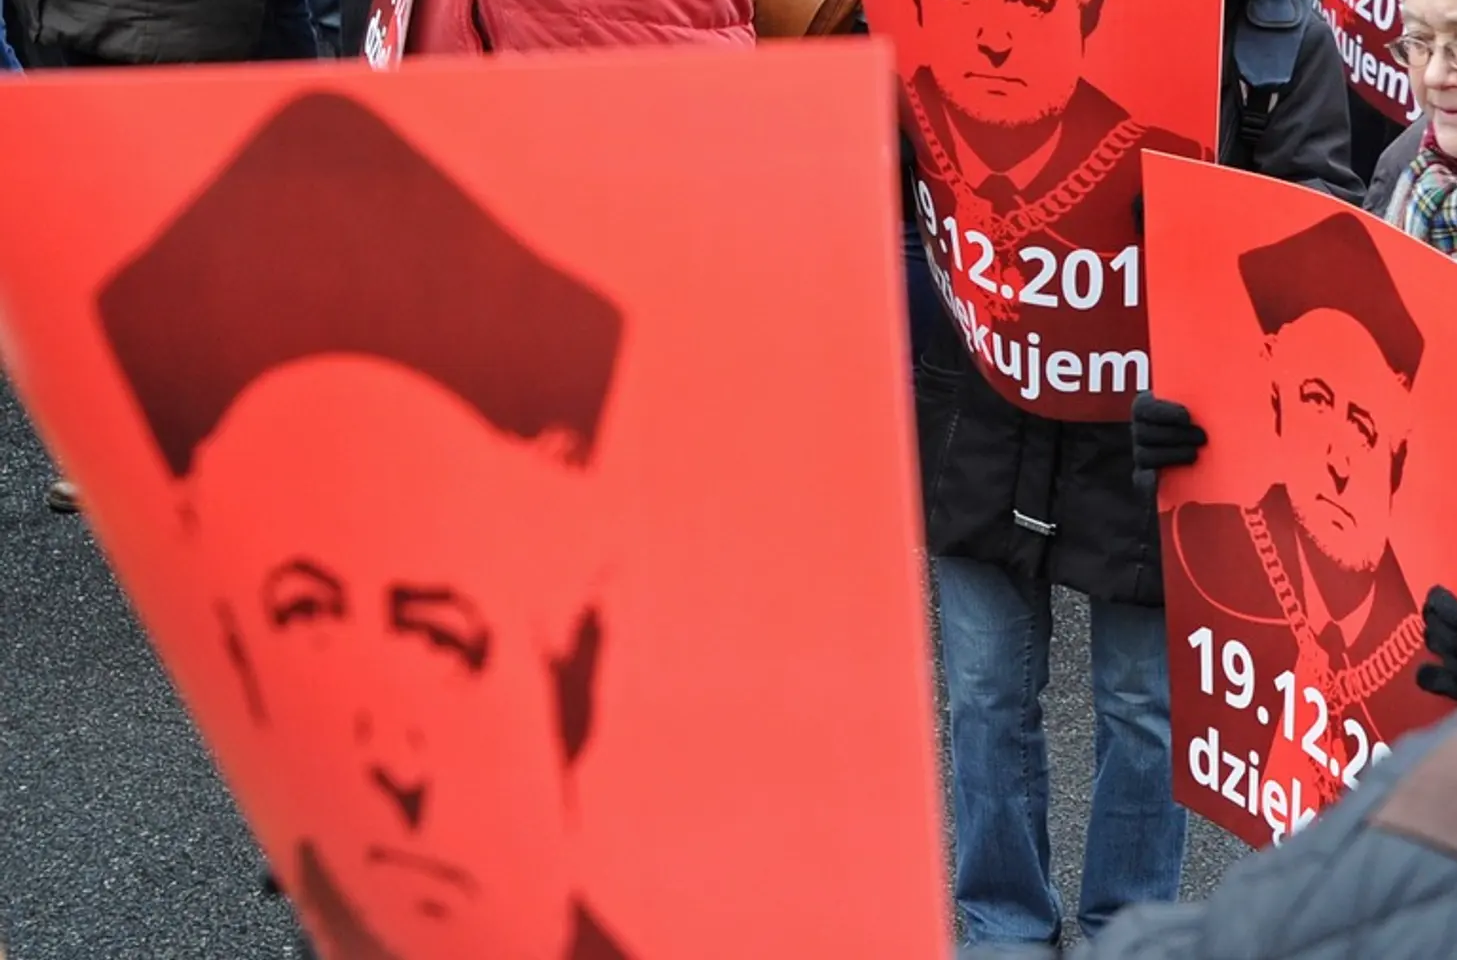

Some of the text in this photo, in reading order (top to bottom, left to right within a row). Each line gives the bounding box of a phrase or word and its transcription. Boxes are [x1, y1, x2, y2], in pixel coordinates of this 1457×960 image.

[912, 170, 1139, 310] 9.12.201
[926, 245, 1149, 400] dziękujem
[1188, 627, 1392, 791] 19.12.2
[1189, 726, 1317, 848] dzięk
